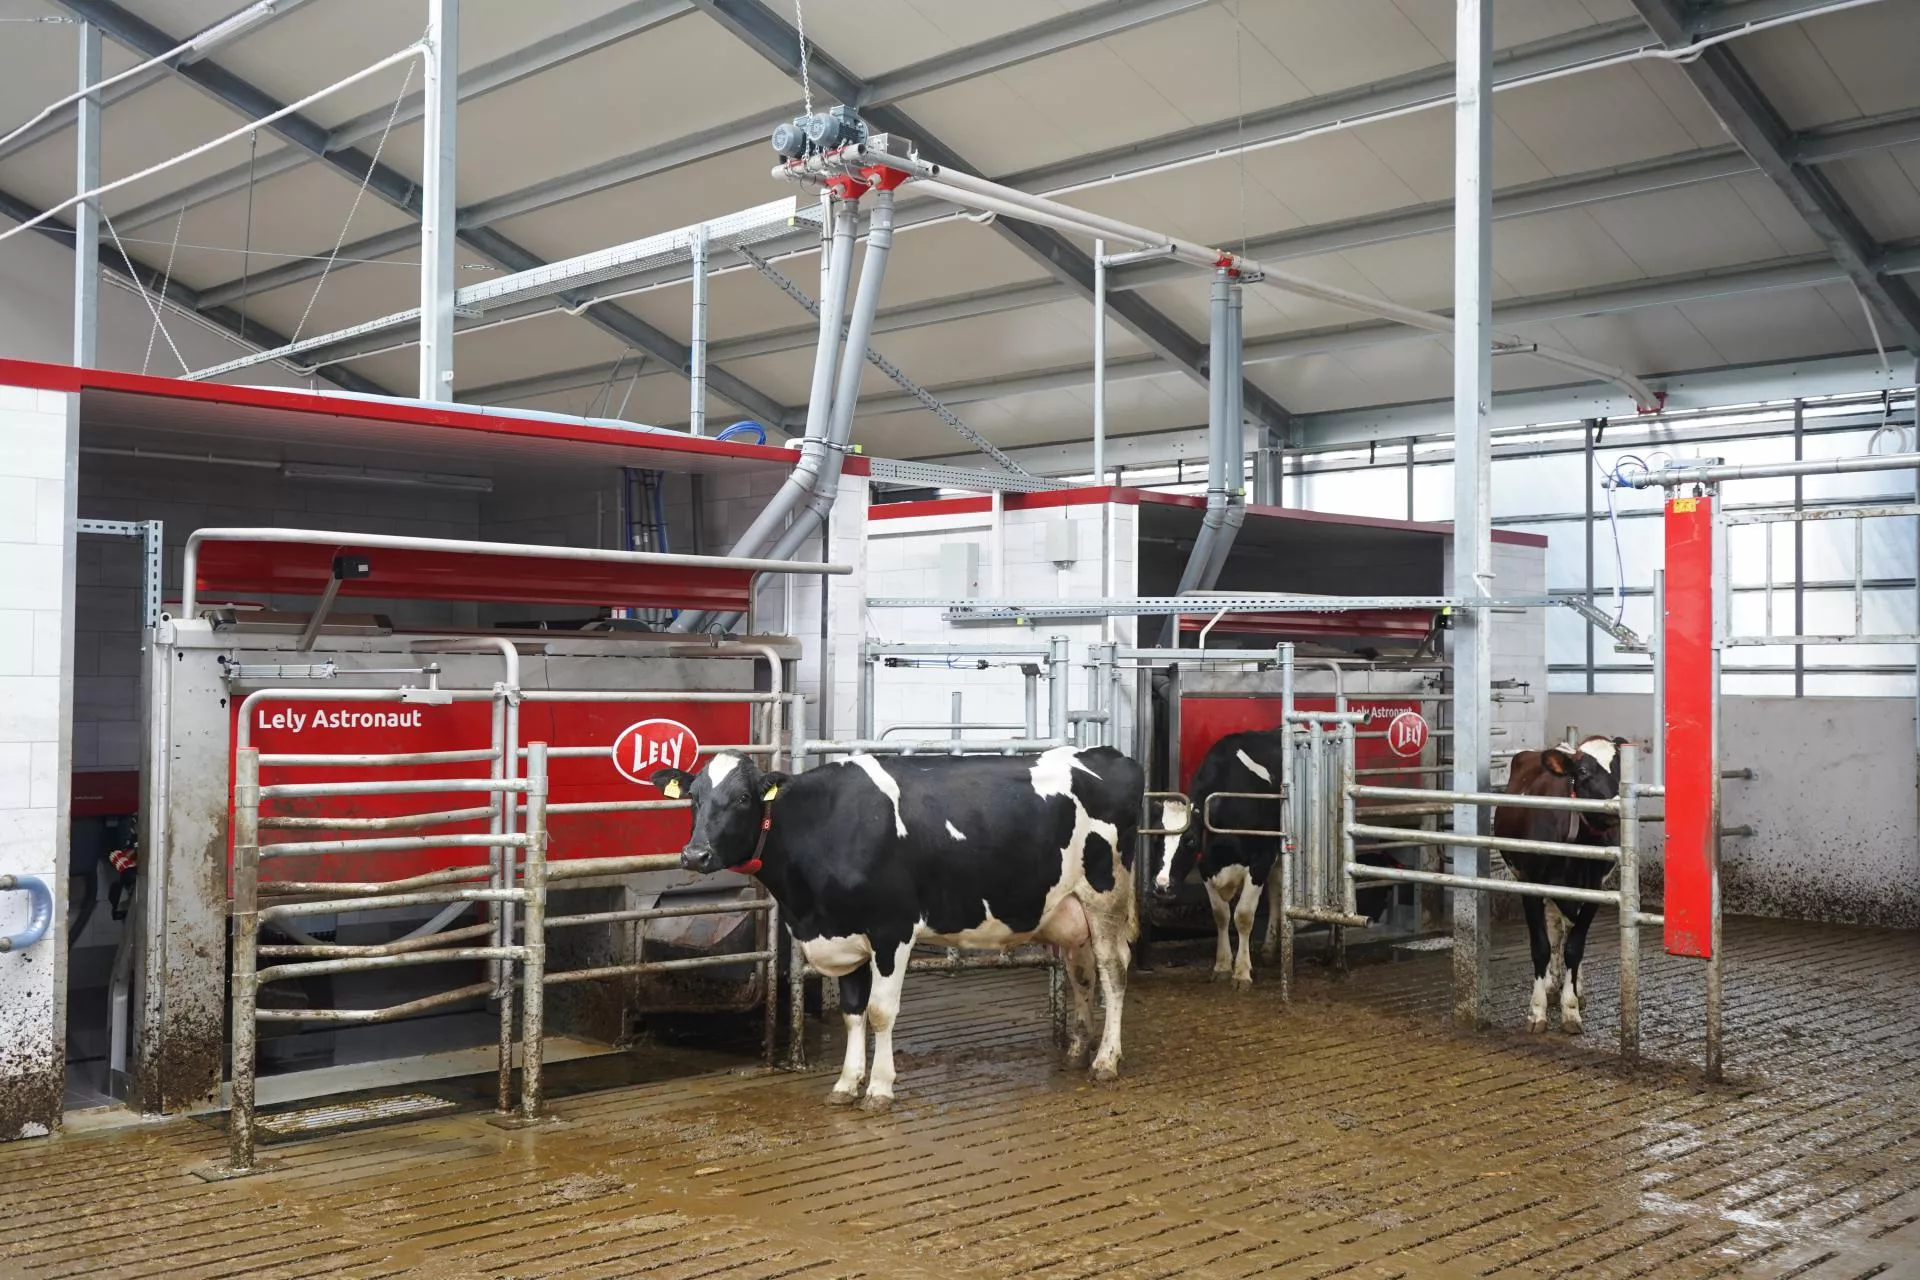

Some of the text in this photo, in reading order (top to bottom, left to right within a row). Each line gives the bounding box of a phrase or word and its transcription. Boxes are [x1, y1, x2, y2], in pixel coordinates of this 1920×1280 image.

[259, 708, 422, 733] Lely Astronaut
[1397, 720, 1422, 748] LELY
[632, 731, 684, 773] LELY
